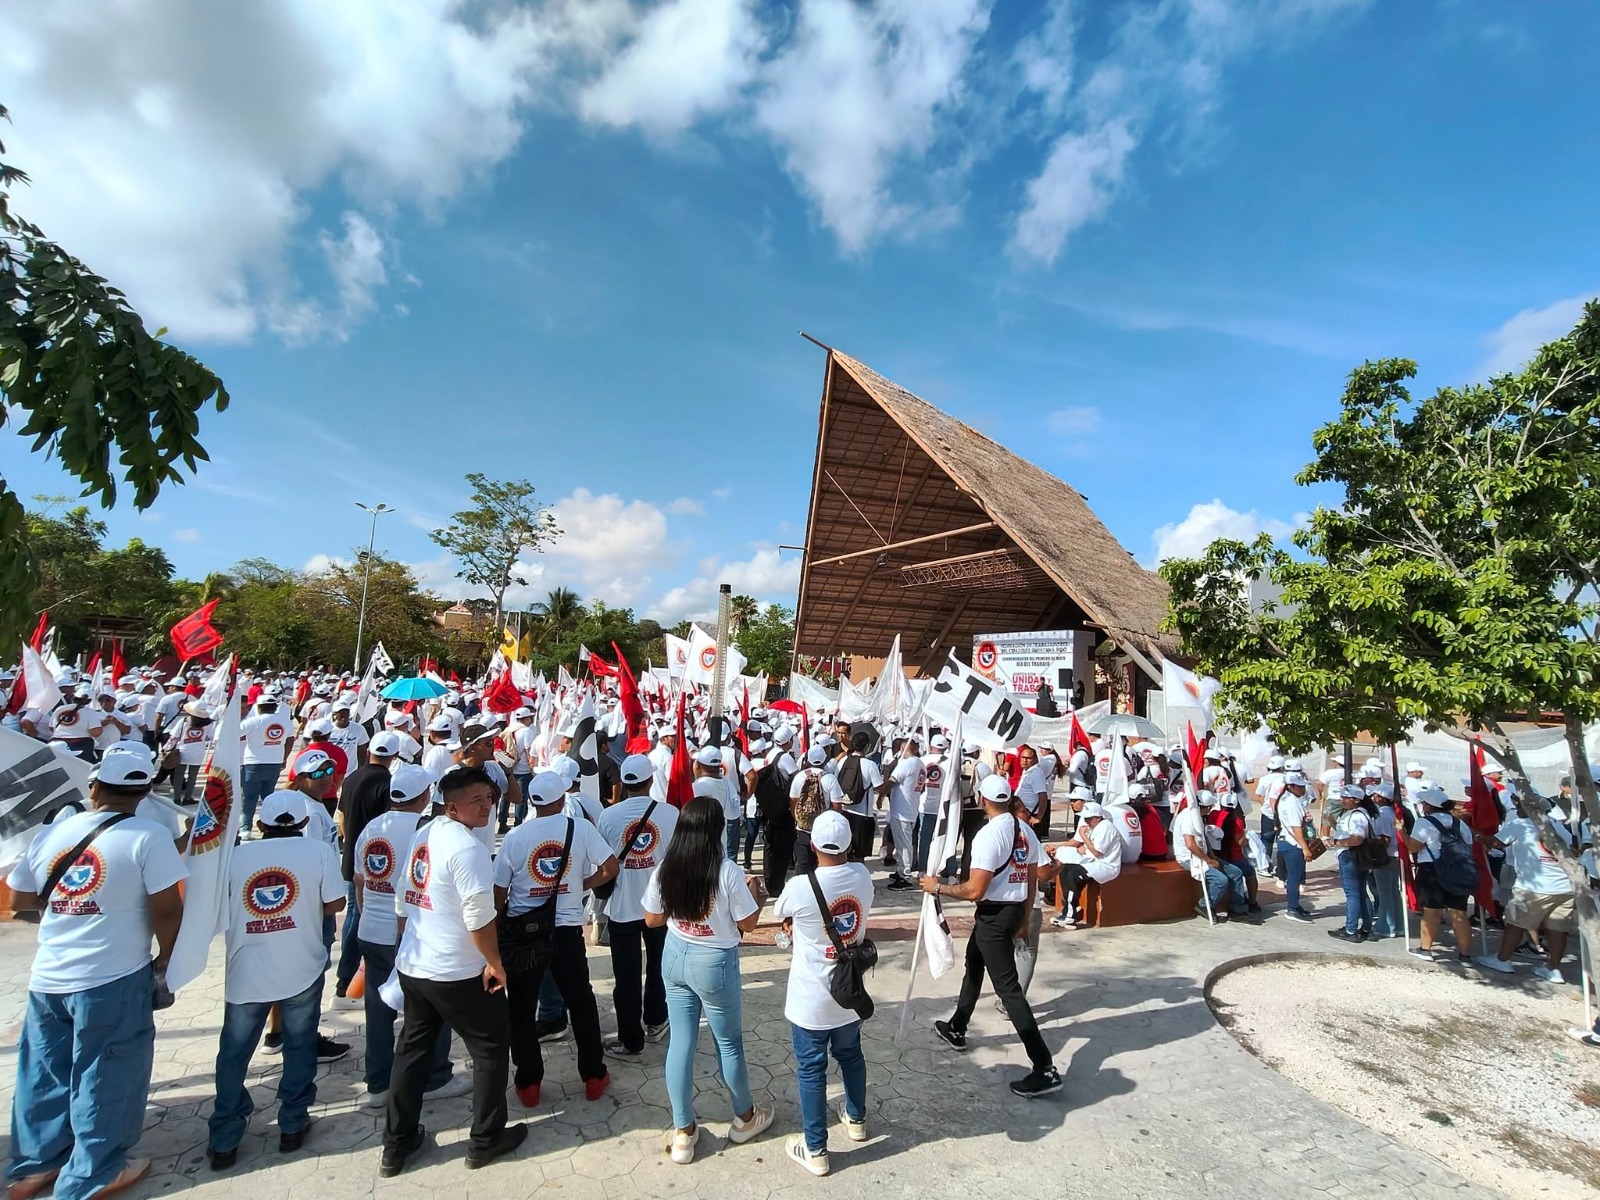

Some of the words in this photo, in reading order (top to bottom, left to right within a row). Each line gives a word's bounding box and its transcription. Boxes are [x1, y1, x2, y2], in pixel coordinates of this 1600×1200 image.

[1013, 676, 1040, 684] UNIDA
[1013, 684, 1053, 692] TRABO
[934, 657, 1024, 742] CTM
